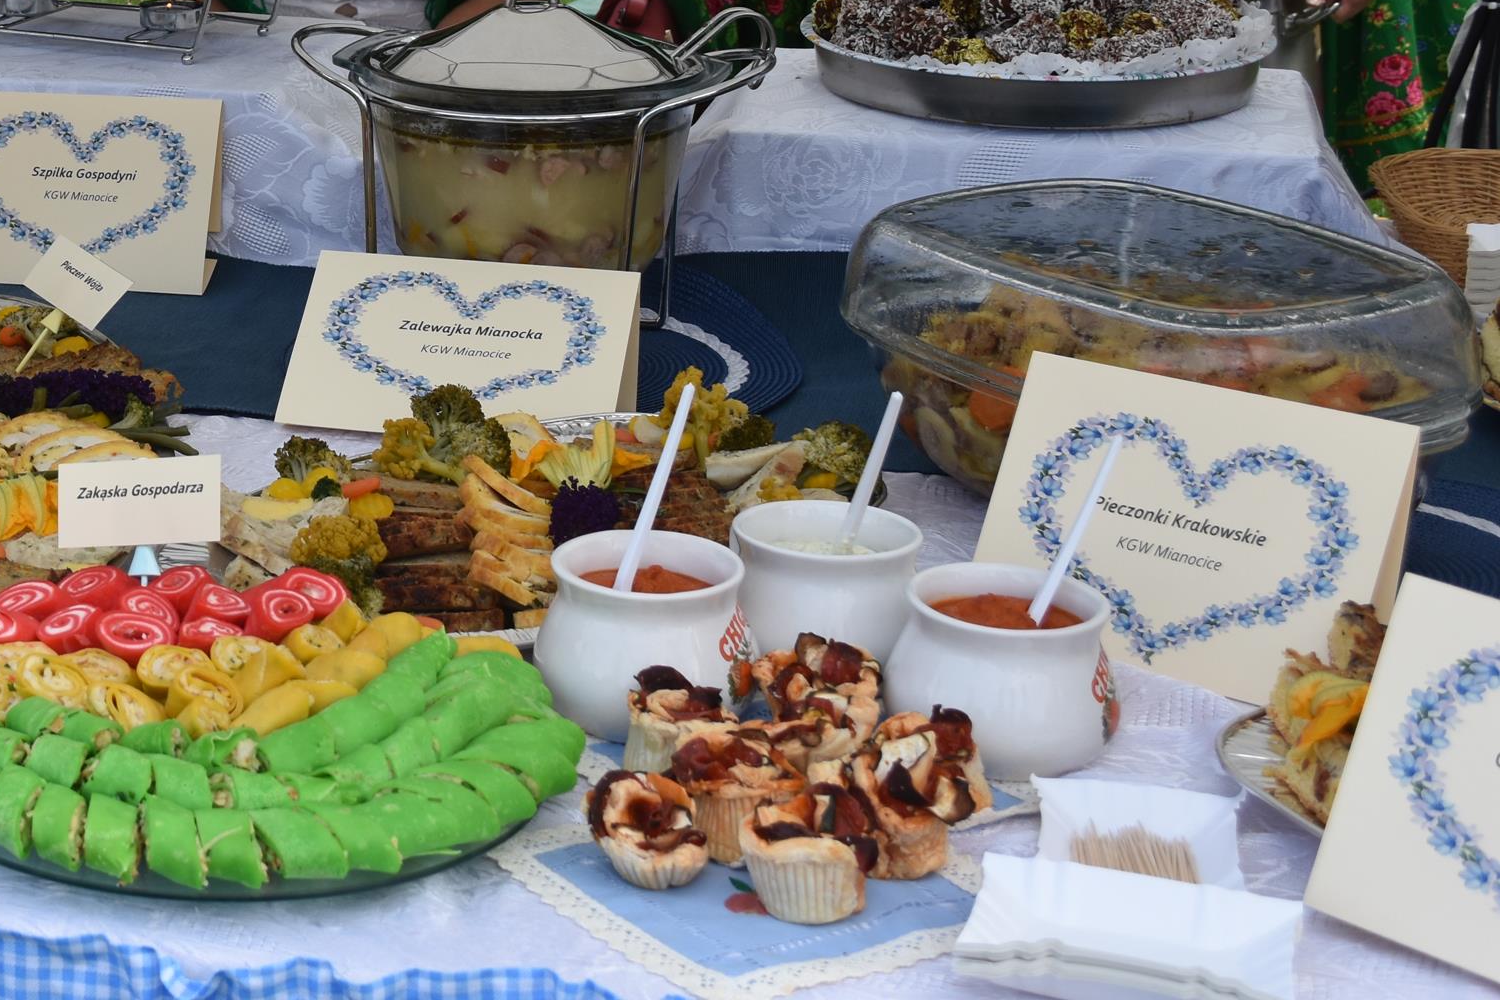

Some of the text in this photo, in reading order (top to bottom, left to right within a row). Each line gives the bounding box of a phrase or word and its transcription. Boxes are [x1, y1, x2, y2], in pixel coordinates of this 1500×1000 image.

[31, 166, 137, 183] Szpilka Gospodyni
[43, 189, 118, 203] KGW Mianocice
[60, 260, 87, 280] Pieczeń
[399, 319, 543, 340] Zalewajka Mianocka
[420, 344, 512, 360] KGW Mianocice
[76, 481, 204, 502] Zakąska Gospodarza
[1171, 513, 1268, 547] Krakowskie
[1115, 535, 1223, 572] KGW Mianocice
